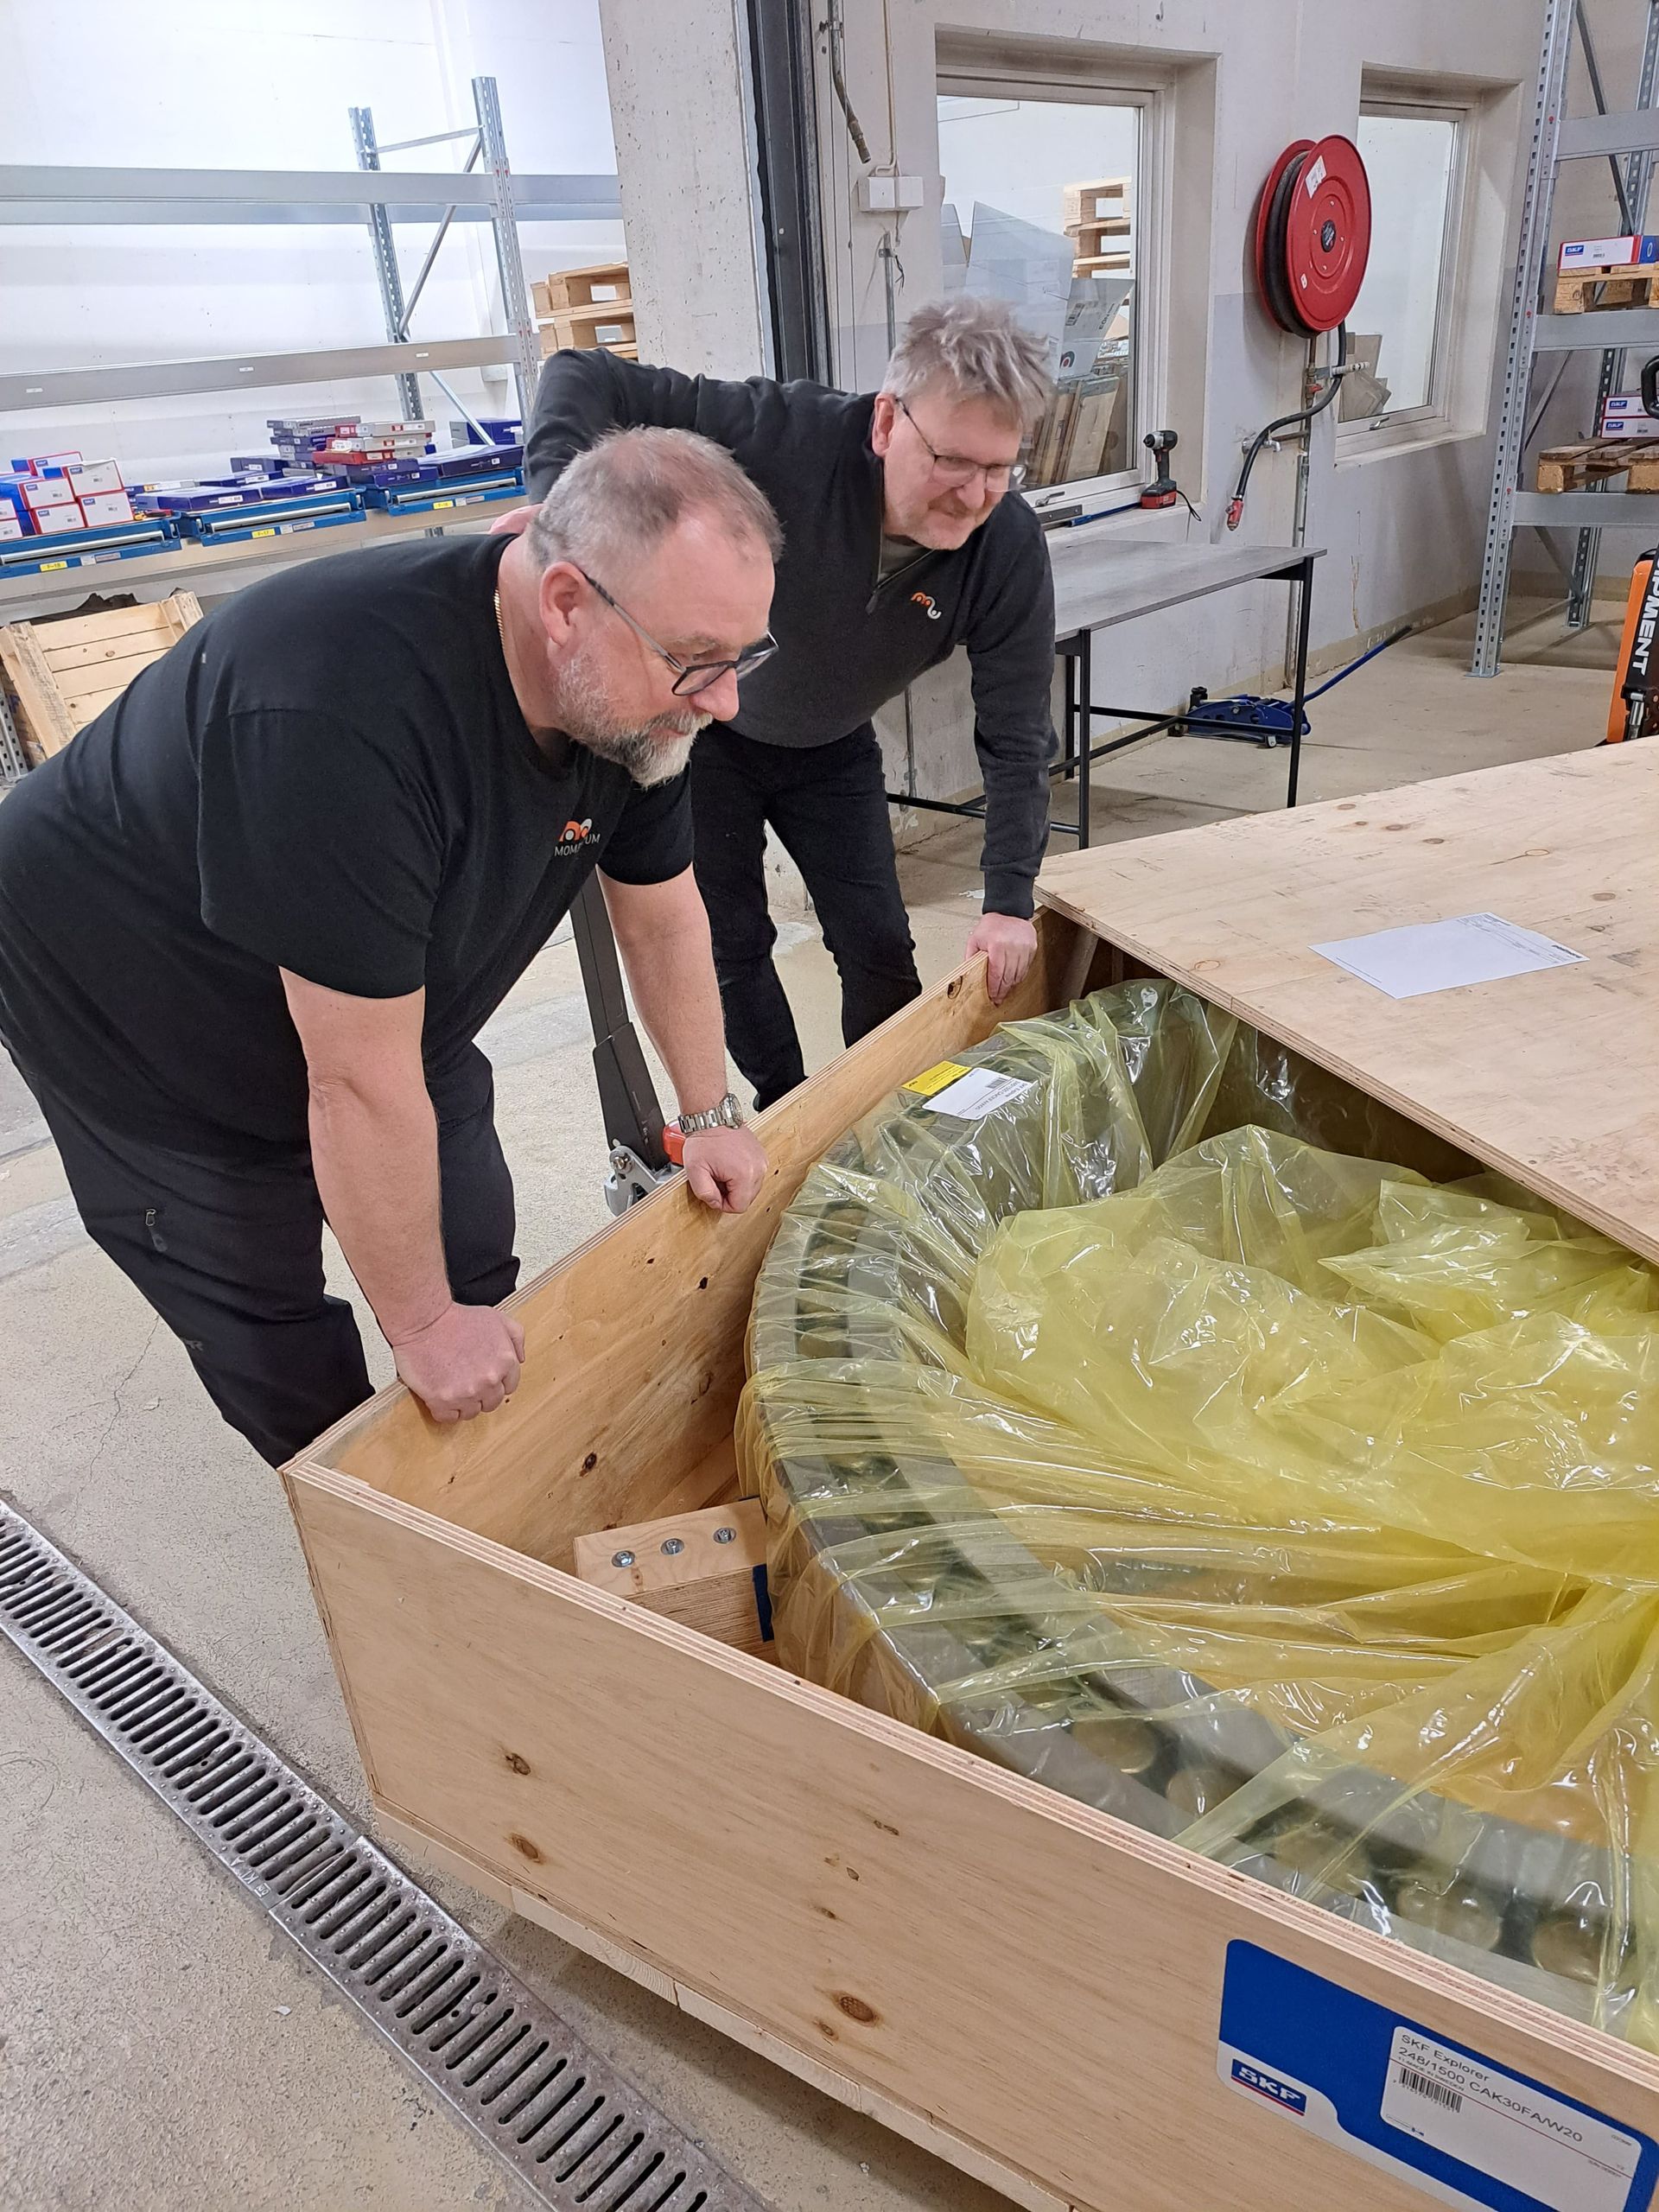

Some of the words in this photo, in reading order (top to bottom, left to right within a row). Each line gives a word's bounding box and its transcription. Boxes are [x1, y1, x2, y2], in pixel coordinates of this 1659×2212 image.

[1398, 2047, 1465, 2085] 248/1500
[1401, 2034, 1430, 2051] SKF
[1433, 2050, 1490, 2082] Explorer
[1238, 2066, 1301, 2101] SKF
